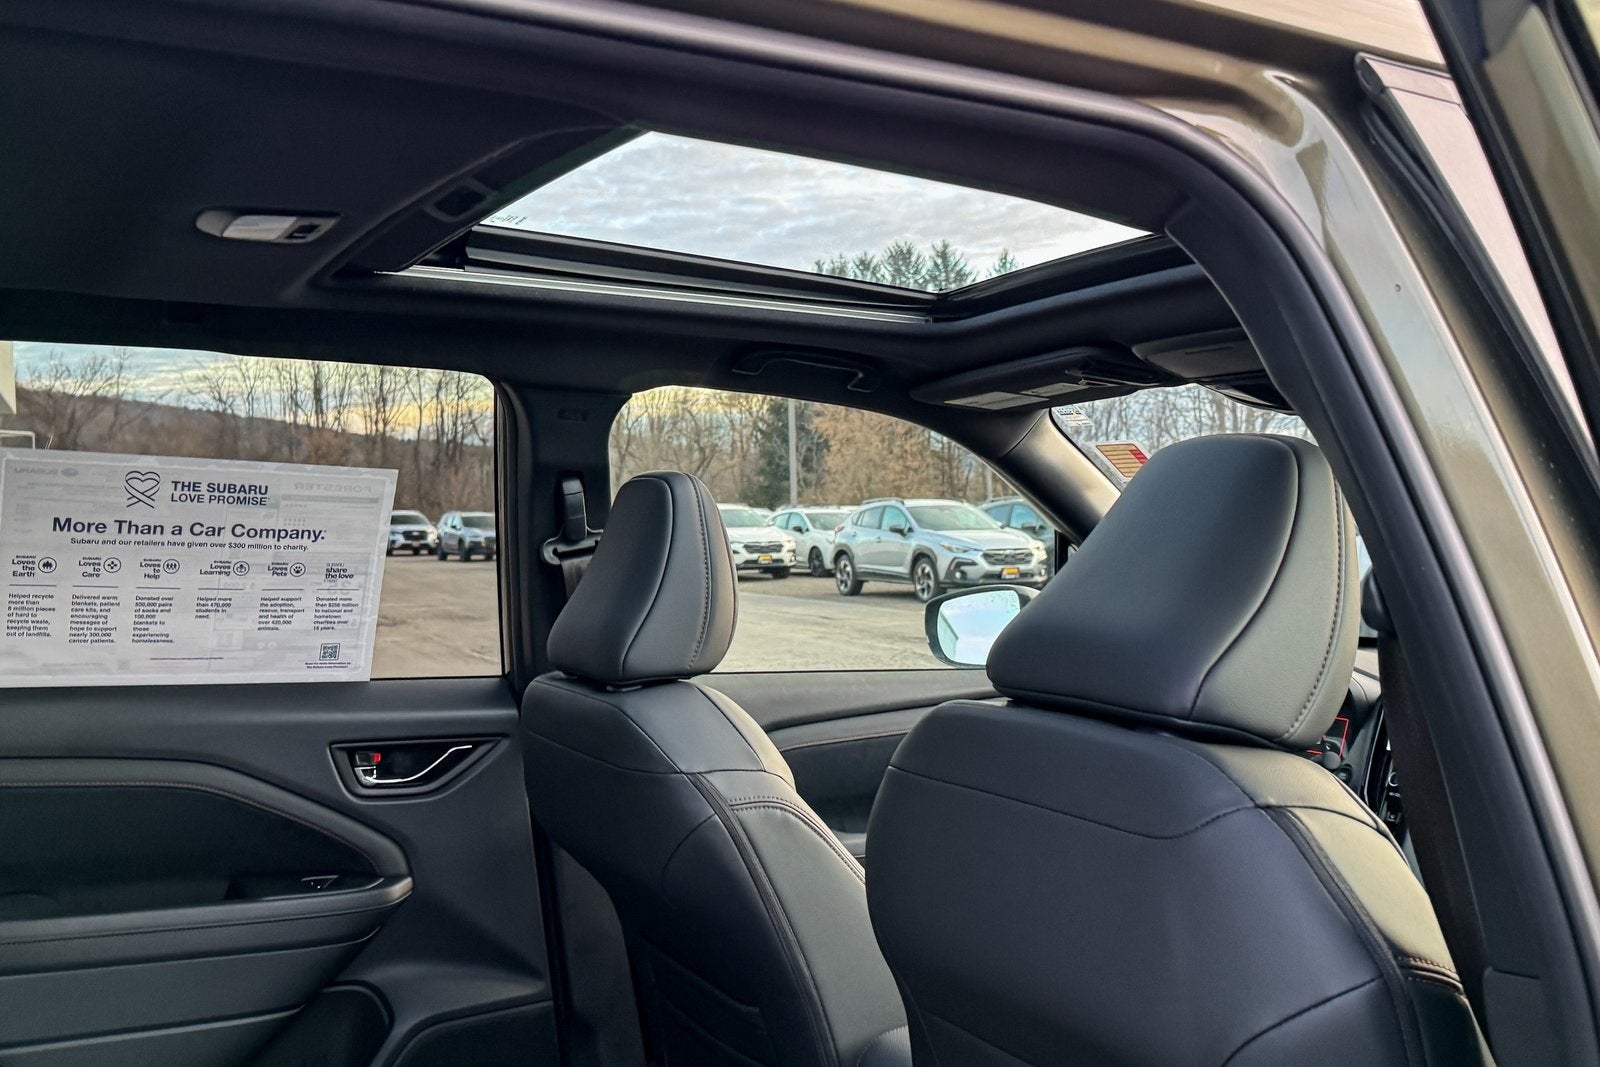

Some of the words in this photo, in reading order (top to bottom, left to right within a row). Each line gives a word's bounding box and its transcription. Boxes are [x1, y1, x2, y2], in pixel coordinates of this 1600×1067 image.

[171, 481, 202, 492] THE
[206, 482, 269, 495] SUBARU
[171, 493, 205, 504] LOVE
[208, 494, 268, 506] PROMISE
[52, 517, 107, 534] More
[114, 519, 164, 536] Than
[171, 525, 183, 536] a
[189, 522, 225, 538] Car
[231, 523, 326, 542] Company.
[70, 537, 100, 545] Subaru
[133, 539, 165, 547] retailers
[167, 539, 185, 547] have
[187, 540, 208, 549] given
[228, 541, 246, 549] $300
[247, 542, 272, 550] million
[283, 543, 309, 552] charity.
